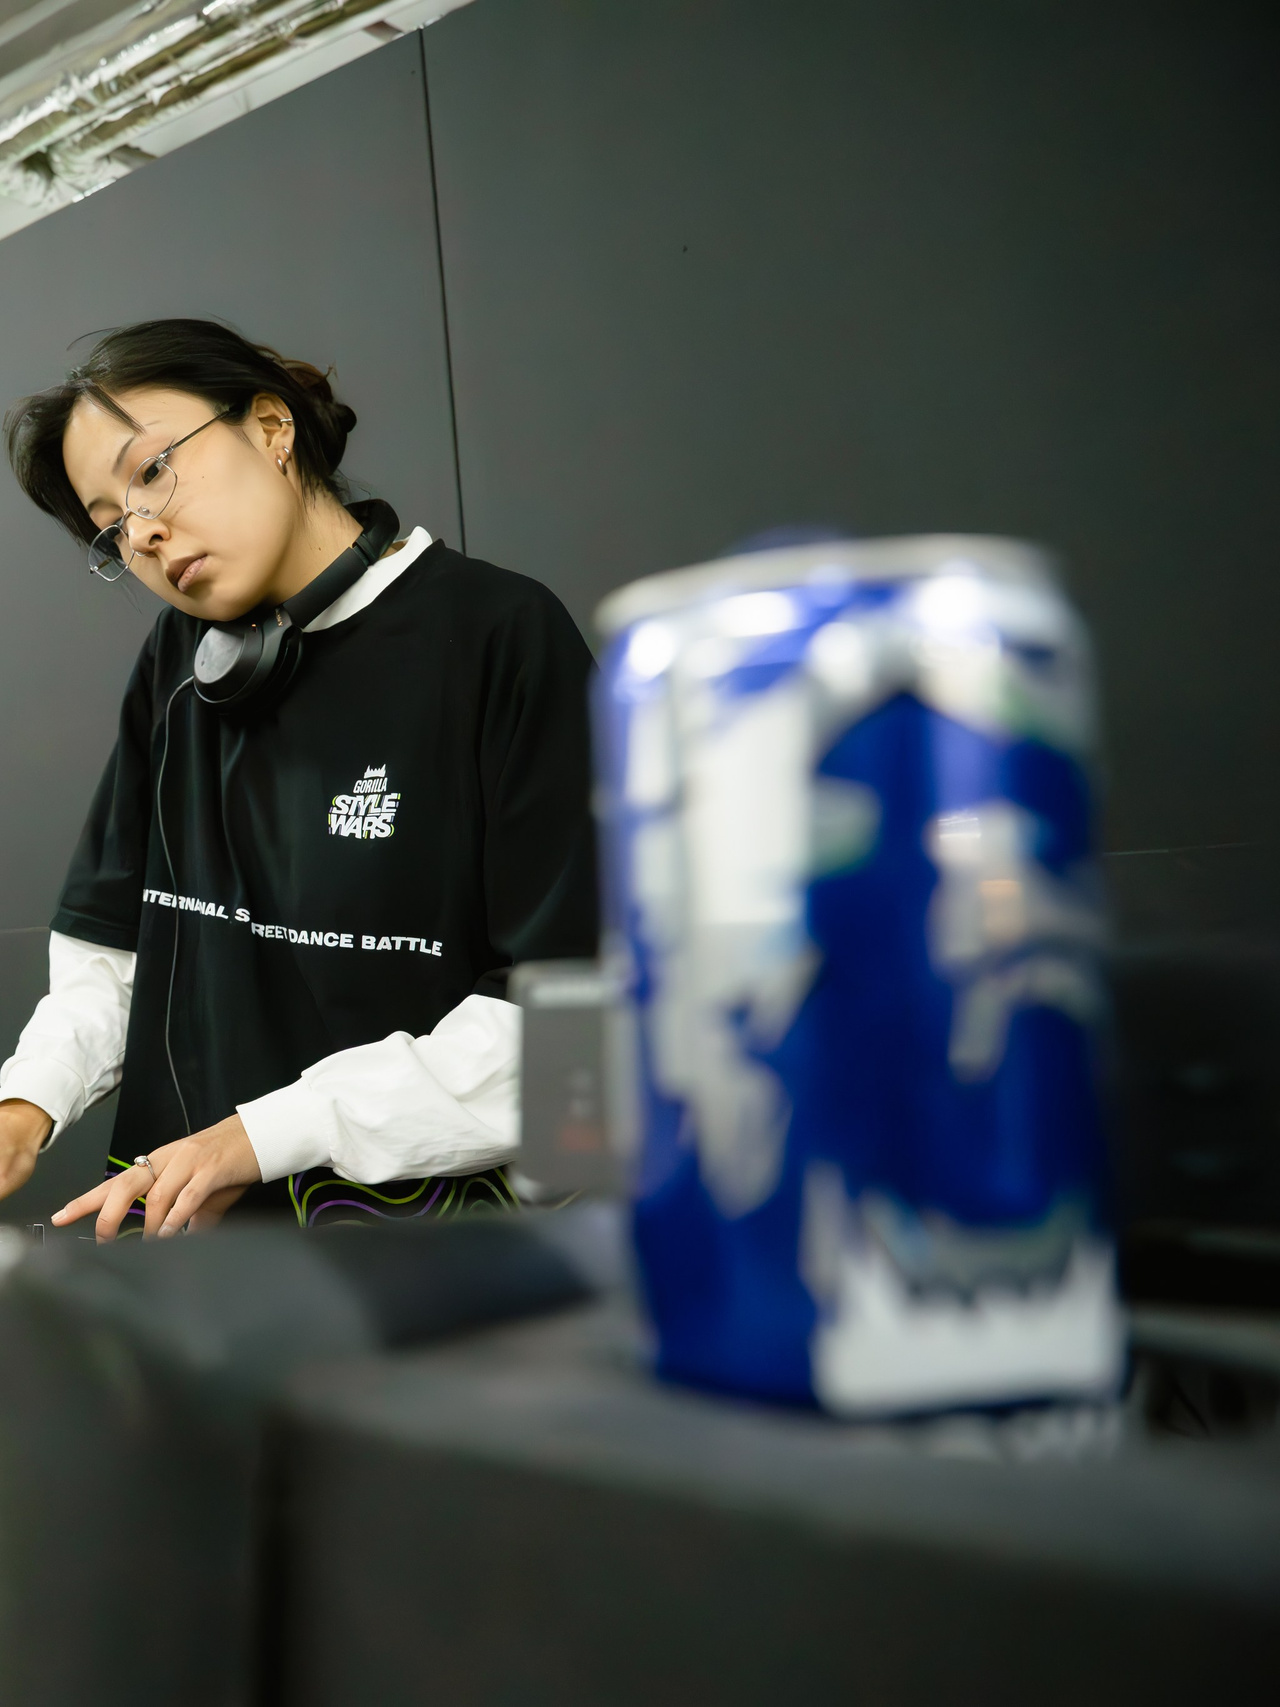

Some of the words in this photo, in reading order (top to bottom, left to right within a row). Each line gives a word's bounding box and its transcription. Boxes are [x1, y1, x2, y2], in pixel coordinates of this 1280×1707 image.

[353, 777, 388, 794] GORILLA
[329, 793, 401, 816] STYLE
[328, 813, 396, 840] WARS
[362, 935, 443, 957] BATTLE
